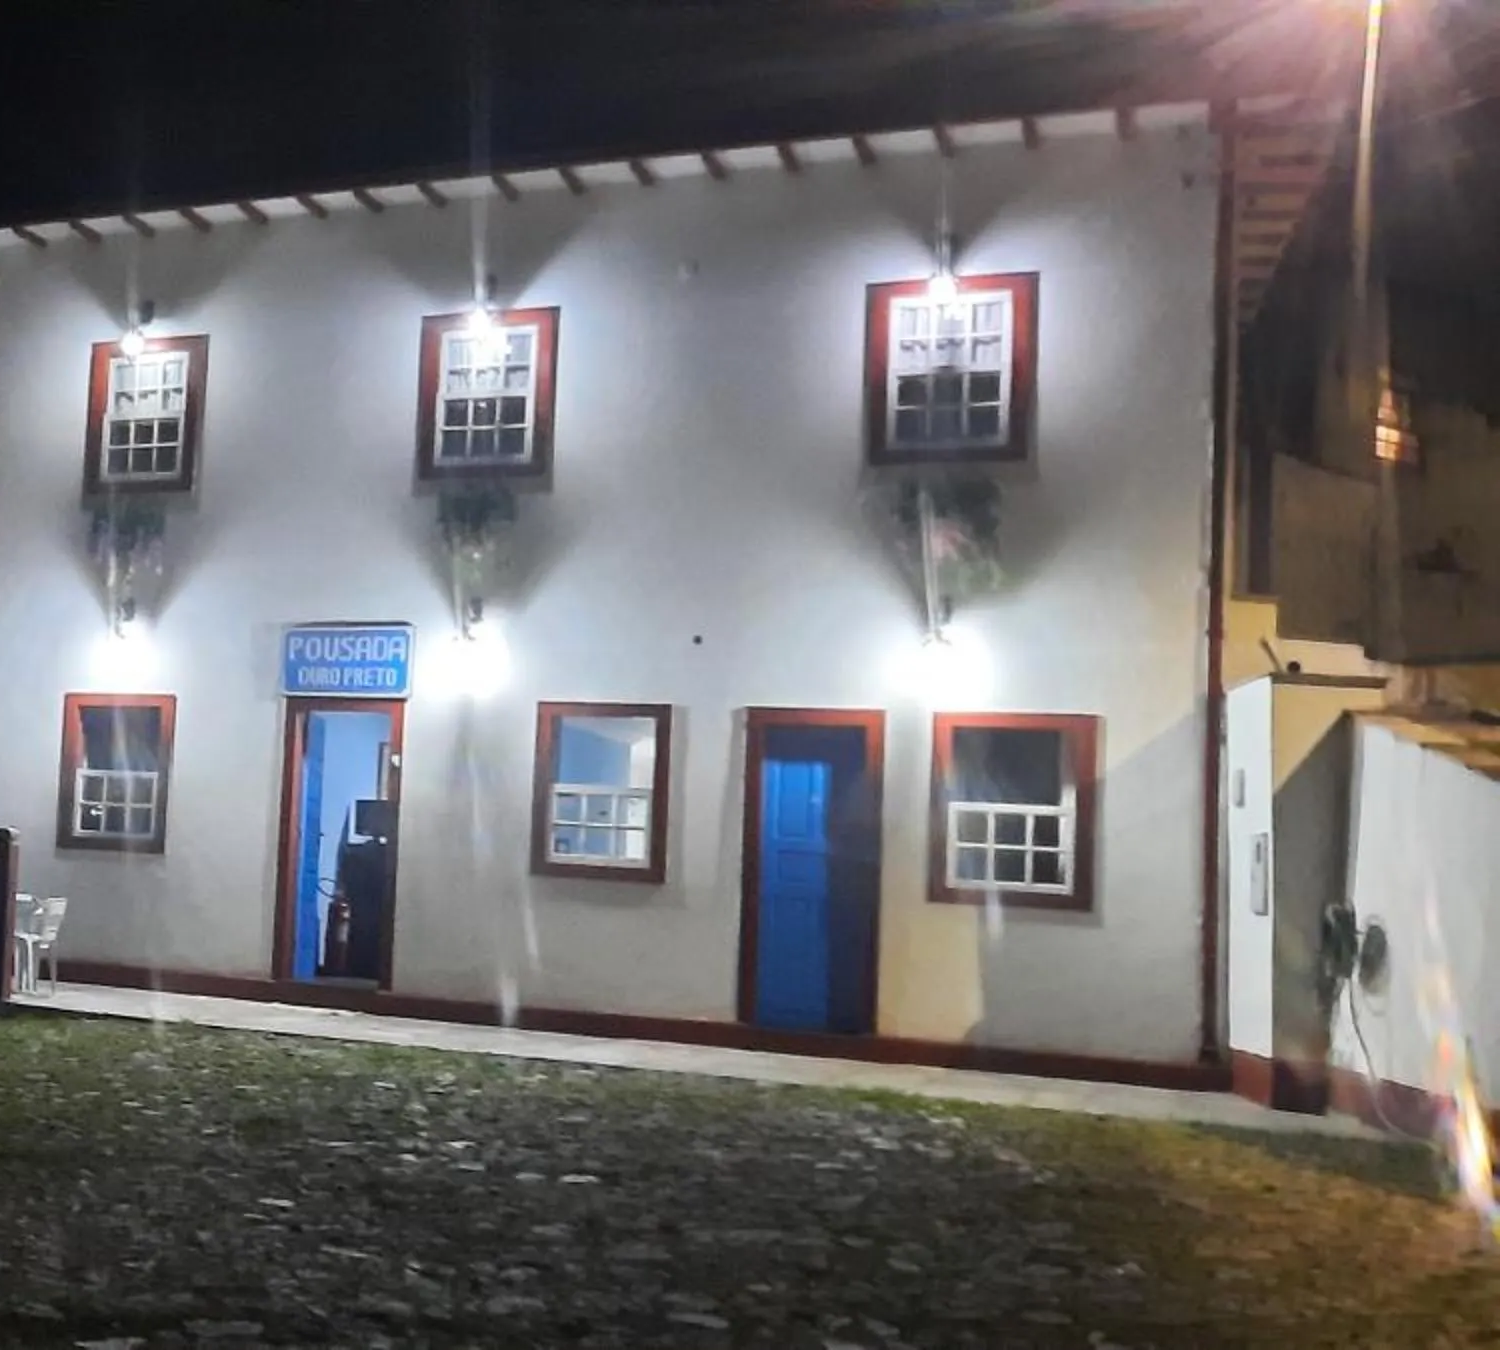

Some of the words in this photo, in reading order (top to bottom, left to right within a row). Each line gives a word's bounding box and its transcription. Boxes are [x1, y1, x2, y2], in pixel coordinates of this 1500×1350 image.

[288, 635, 406, 662] POUSADA
[298, 666, 340, 686] OURO
[343, 667, 398, 687] PRETO
